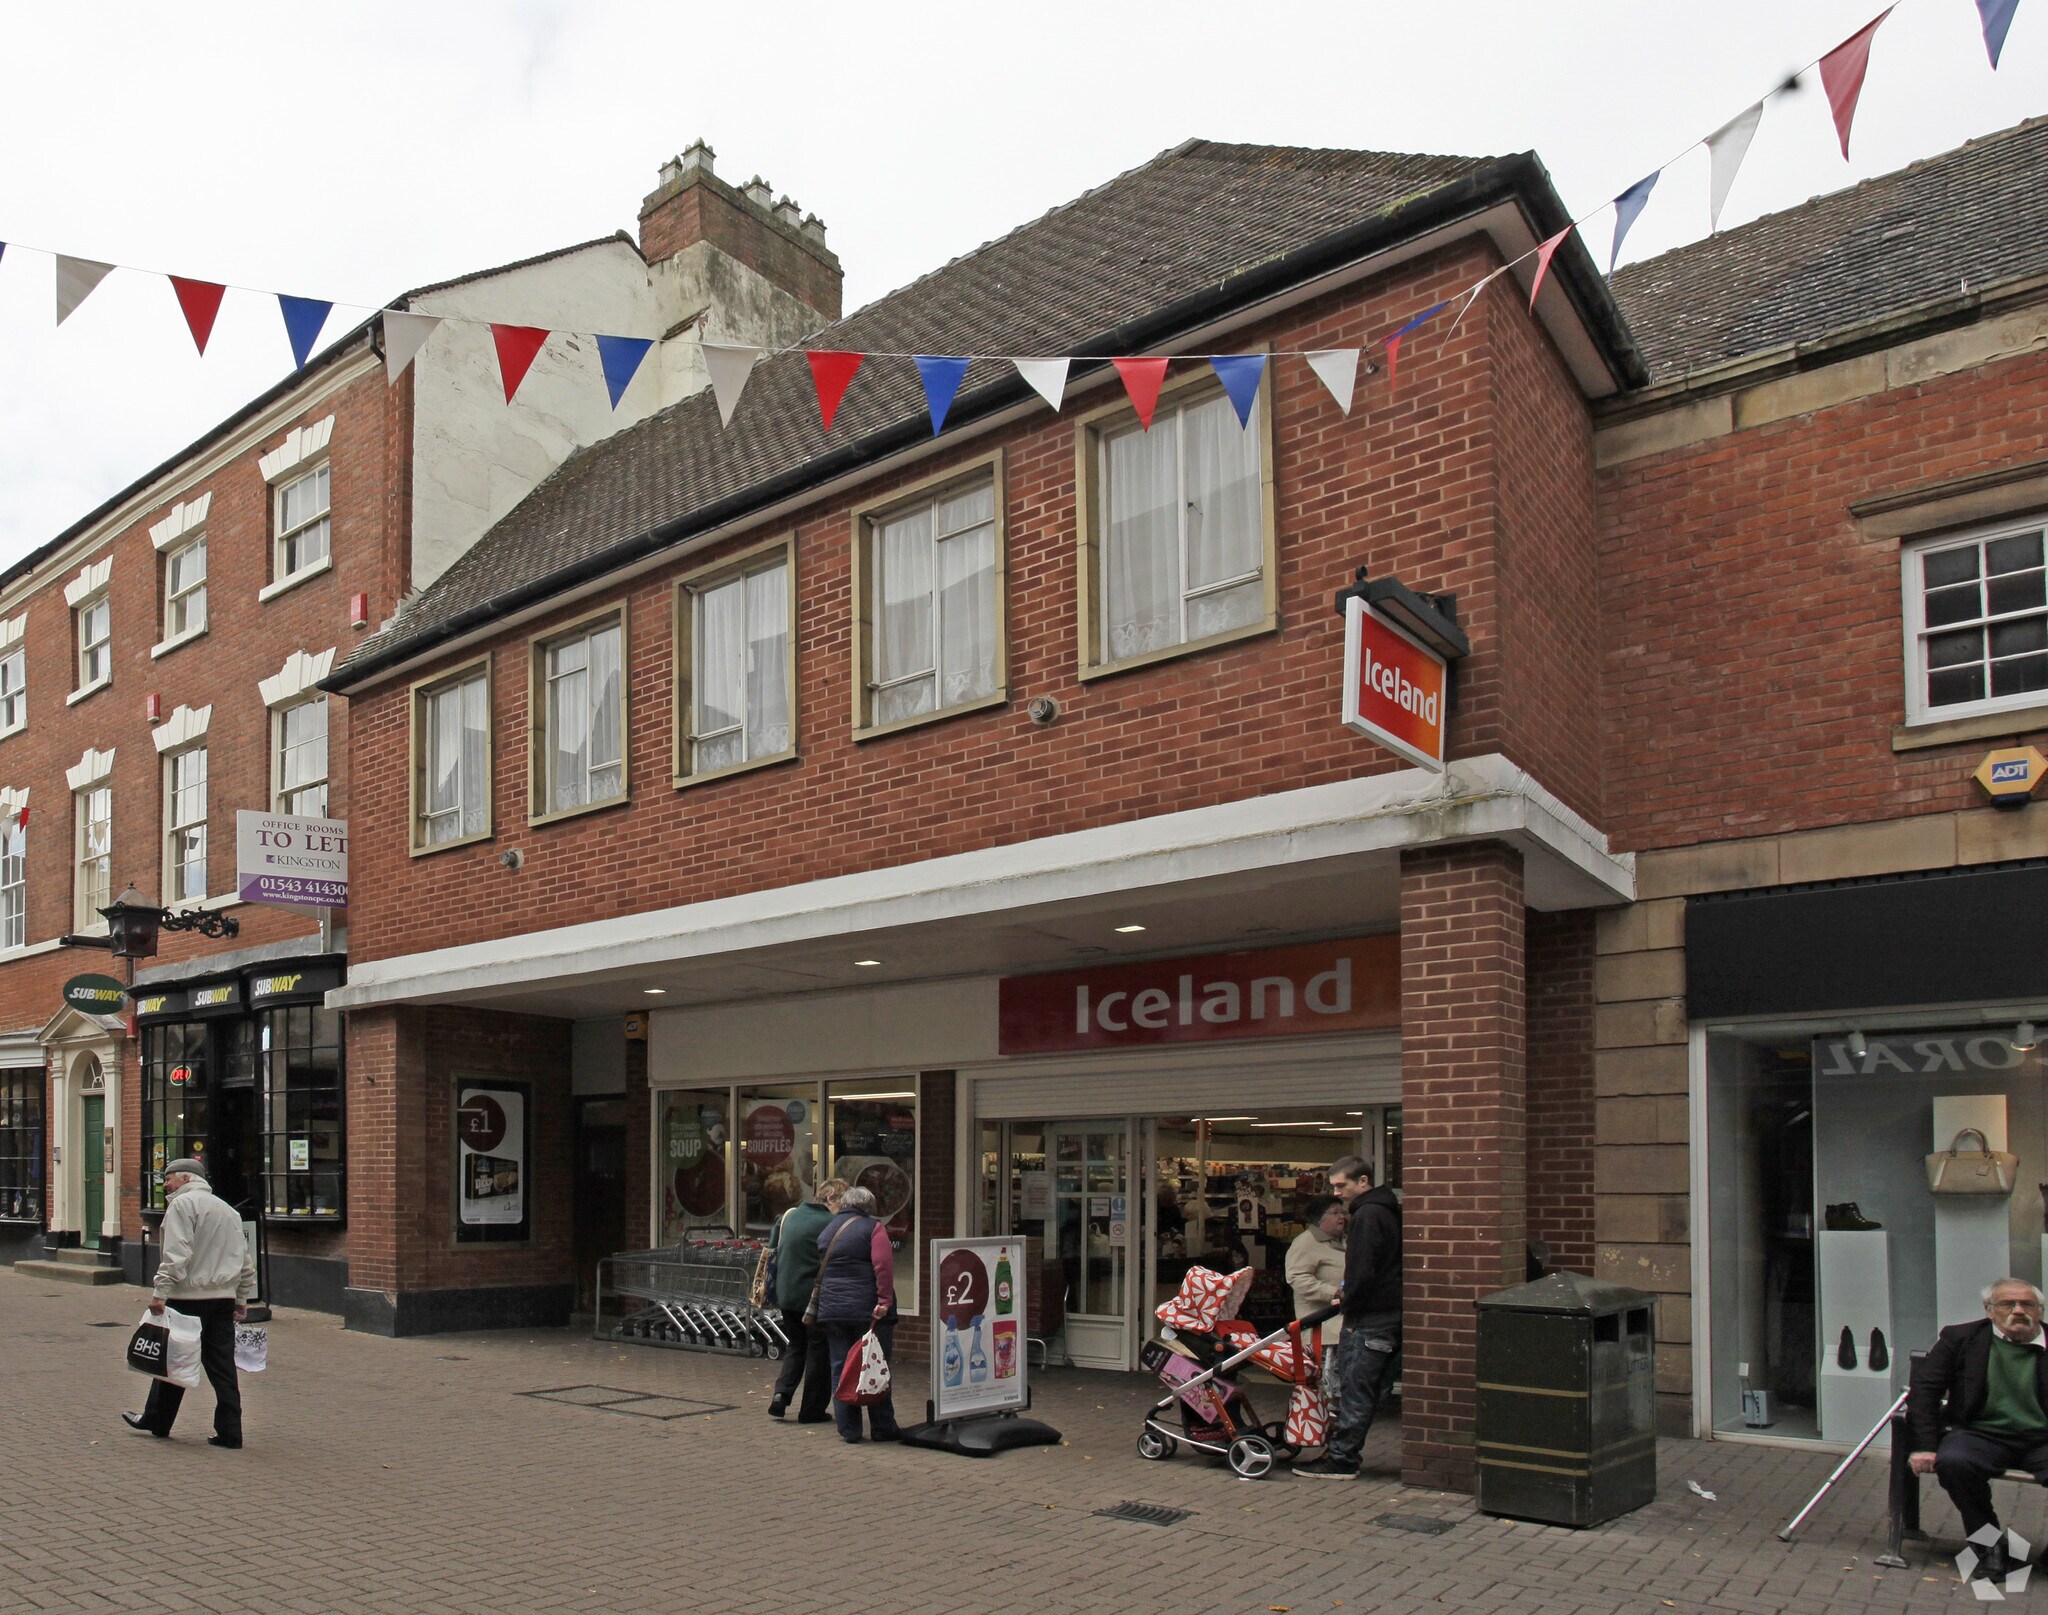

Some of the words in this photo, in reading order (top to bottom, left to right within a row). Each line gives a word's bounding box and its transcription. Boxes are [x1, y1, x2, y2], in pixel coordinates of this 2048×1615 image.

[1364, 648, 1437, 726] Iceland
[1992, 764, 2028, 779] ADT
[262, 820, 300, 831] OFFICE
[306, 824, 344, 834] ROOMS
[256, 830, 292, 848] TO
[305, 834, 348, 853] LET
[277, 855, 340, 869] KINGSTON
[260, 877, 302, 892] 01543
[305, 881, 348, 896] 41430
[262, 891, 346, 904] www.kingstoncpc.co.uk
[69, 987, 124, 1002] SUBWAY
[255, 974, 302, 996] SUBWAY
[195, 986, 232, 1006] SUBWAY
[1076, 957, 1352, 1034] Iceland
[136, 996, 167, 1015] SUBWAY
[470, 1109, 493, 1133] £1
[669, 1139, 702, 1158] SOUP
[747, 1136, 791, 1153] SOUFFLÉS
[946, 1271, 974, 1306] £2
[134, 1337, 161, 1356] BHS
